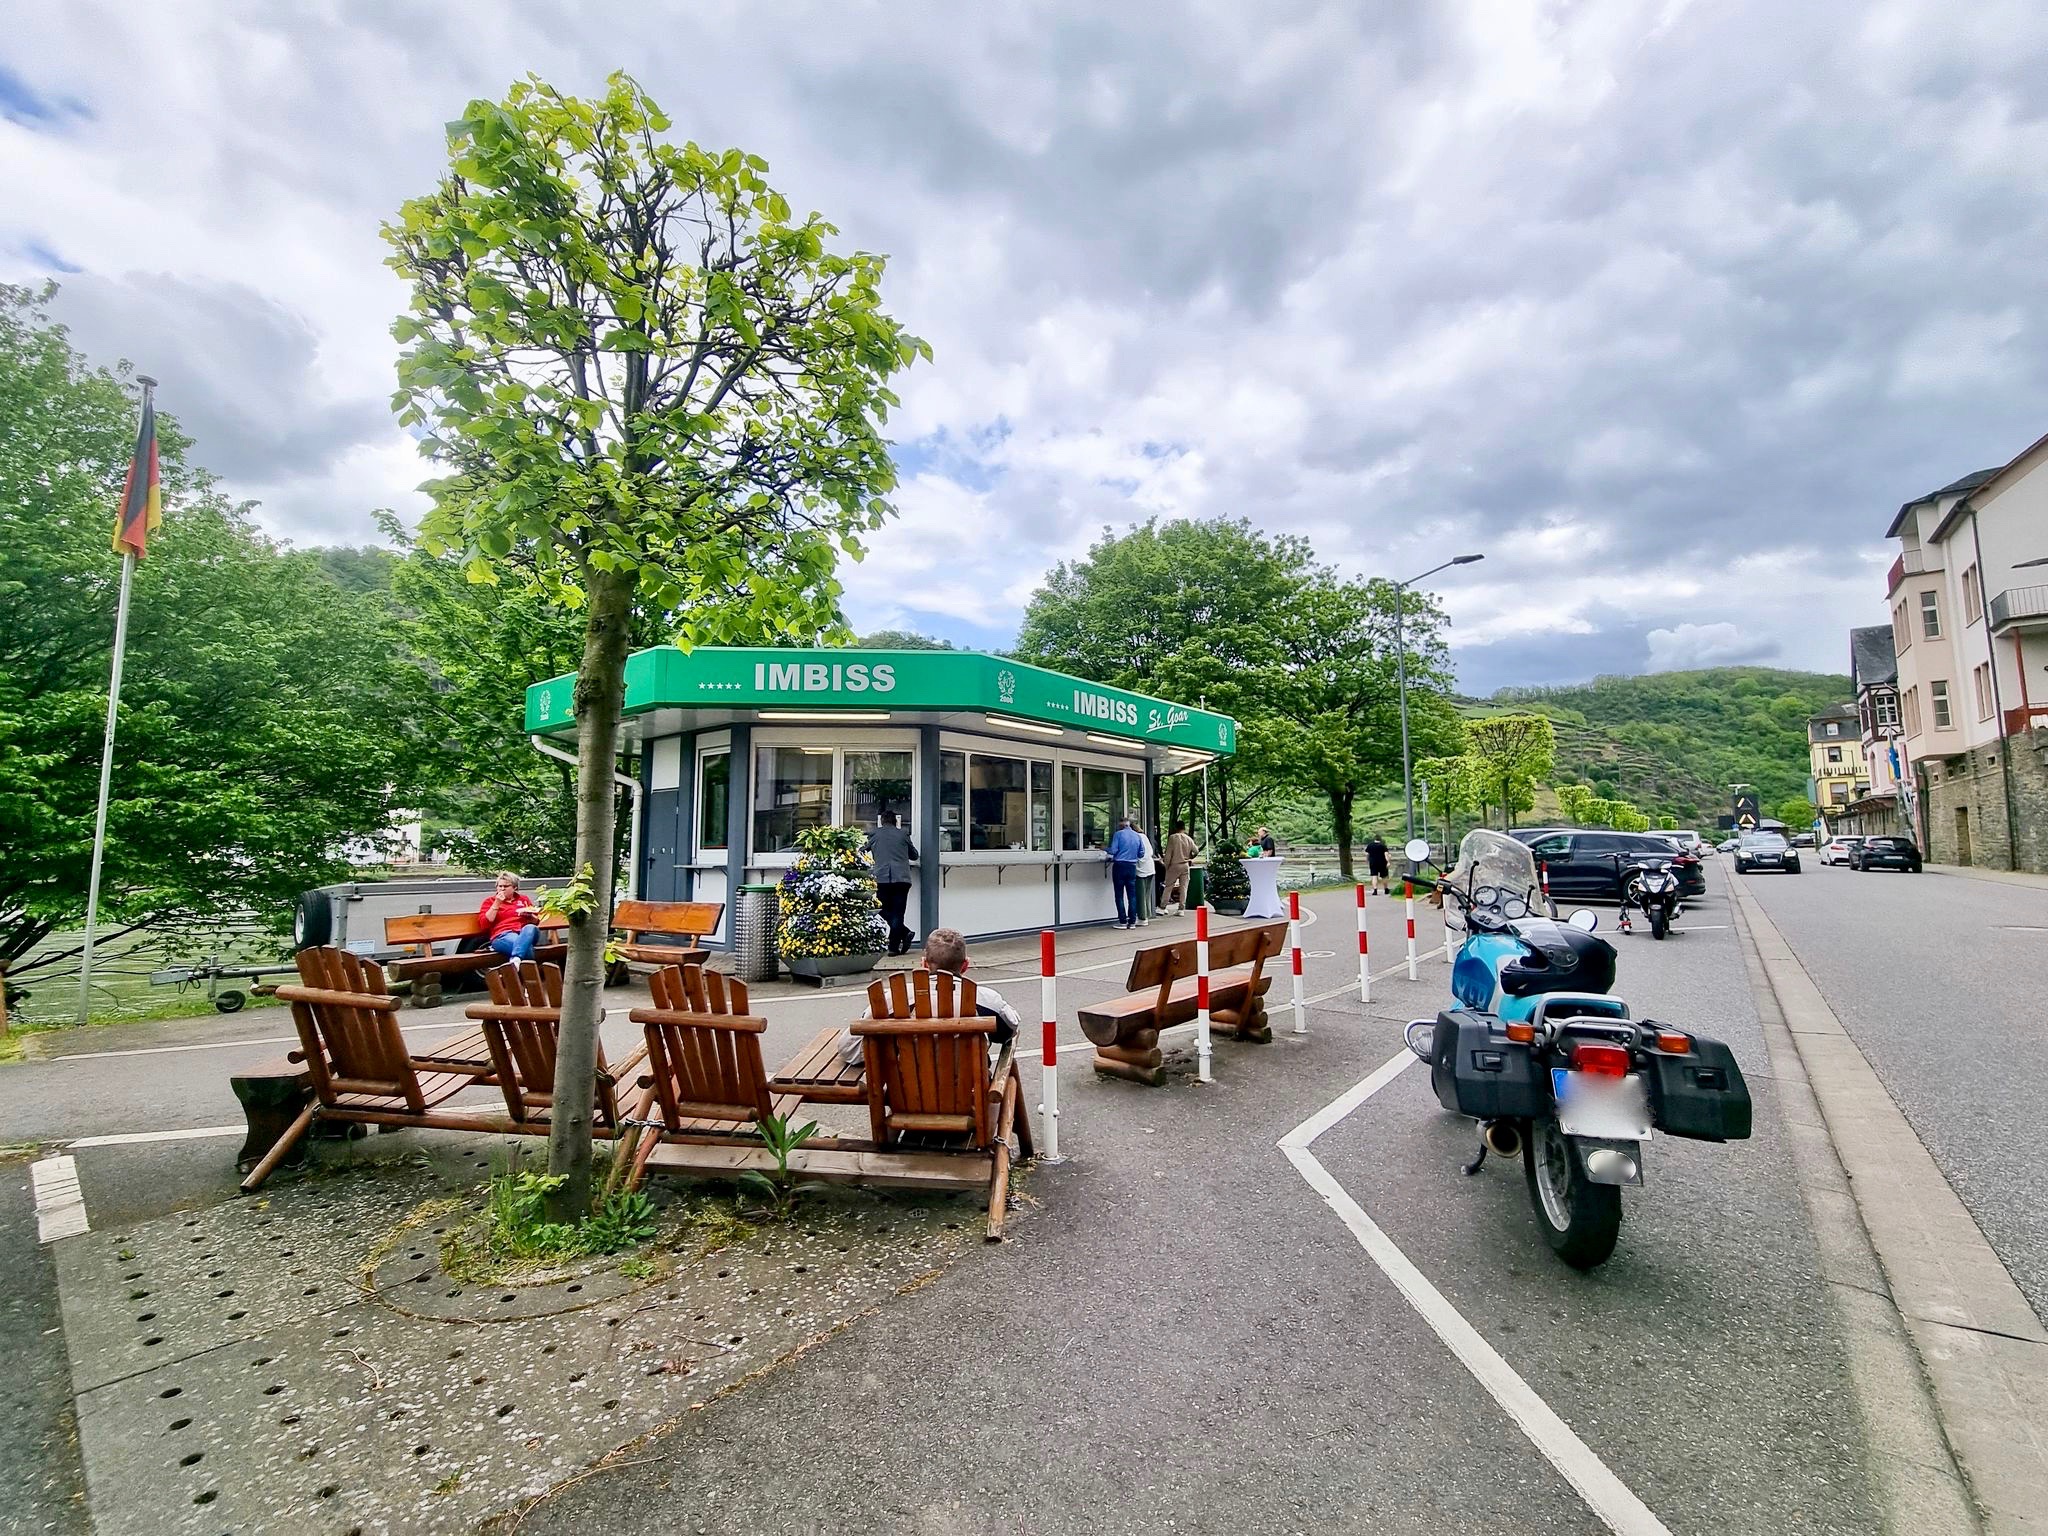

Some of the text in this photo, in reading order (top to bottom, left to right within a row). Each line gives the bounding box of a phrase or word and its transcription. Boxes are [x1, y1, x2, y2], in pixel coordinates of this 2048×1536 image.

[754, 663, 896, 692] IMBISS
[1073, 689, 1189, 731] IMBISS St. Goar
